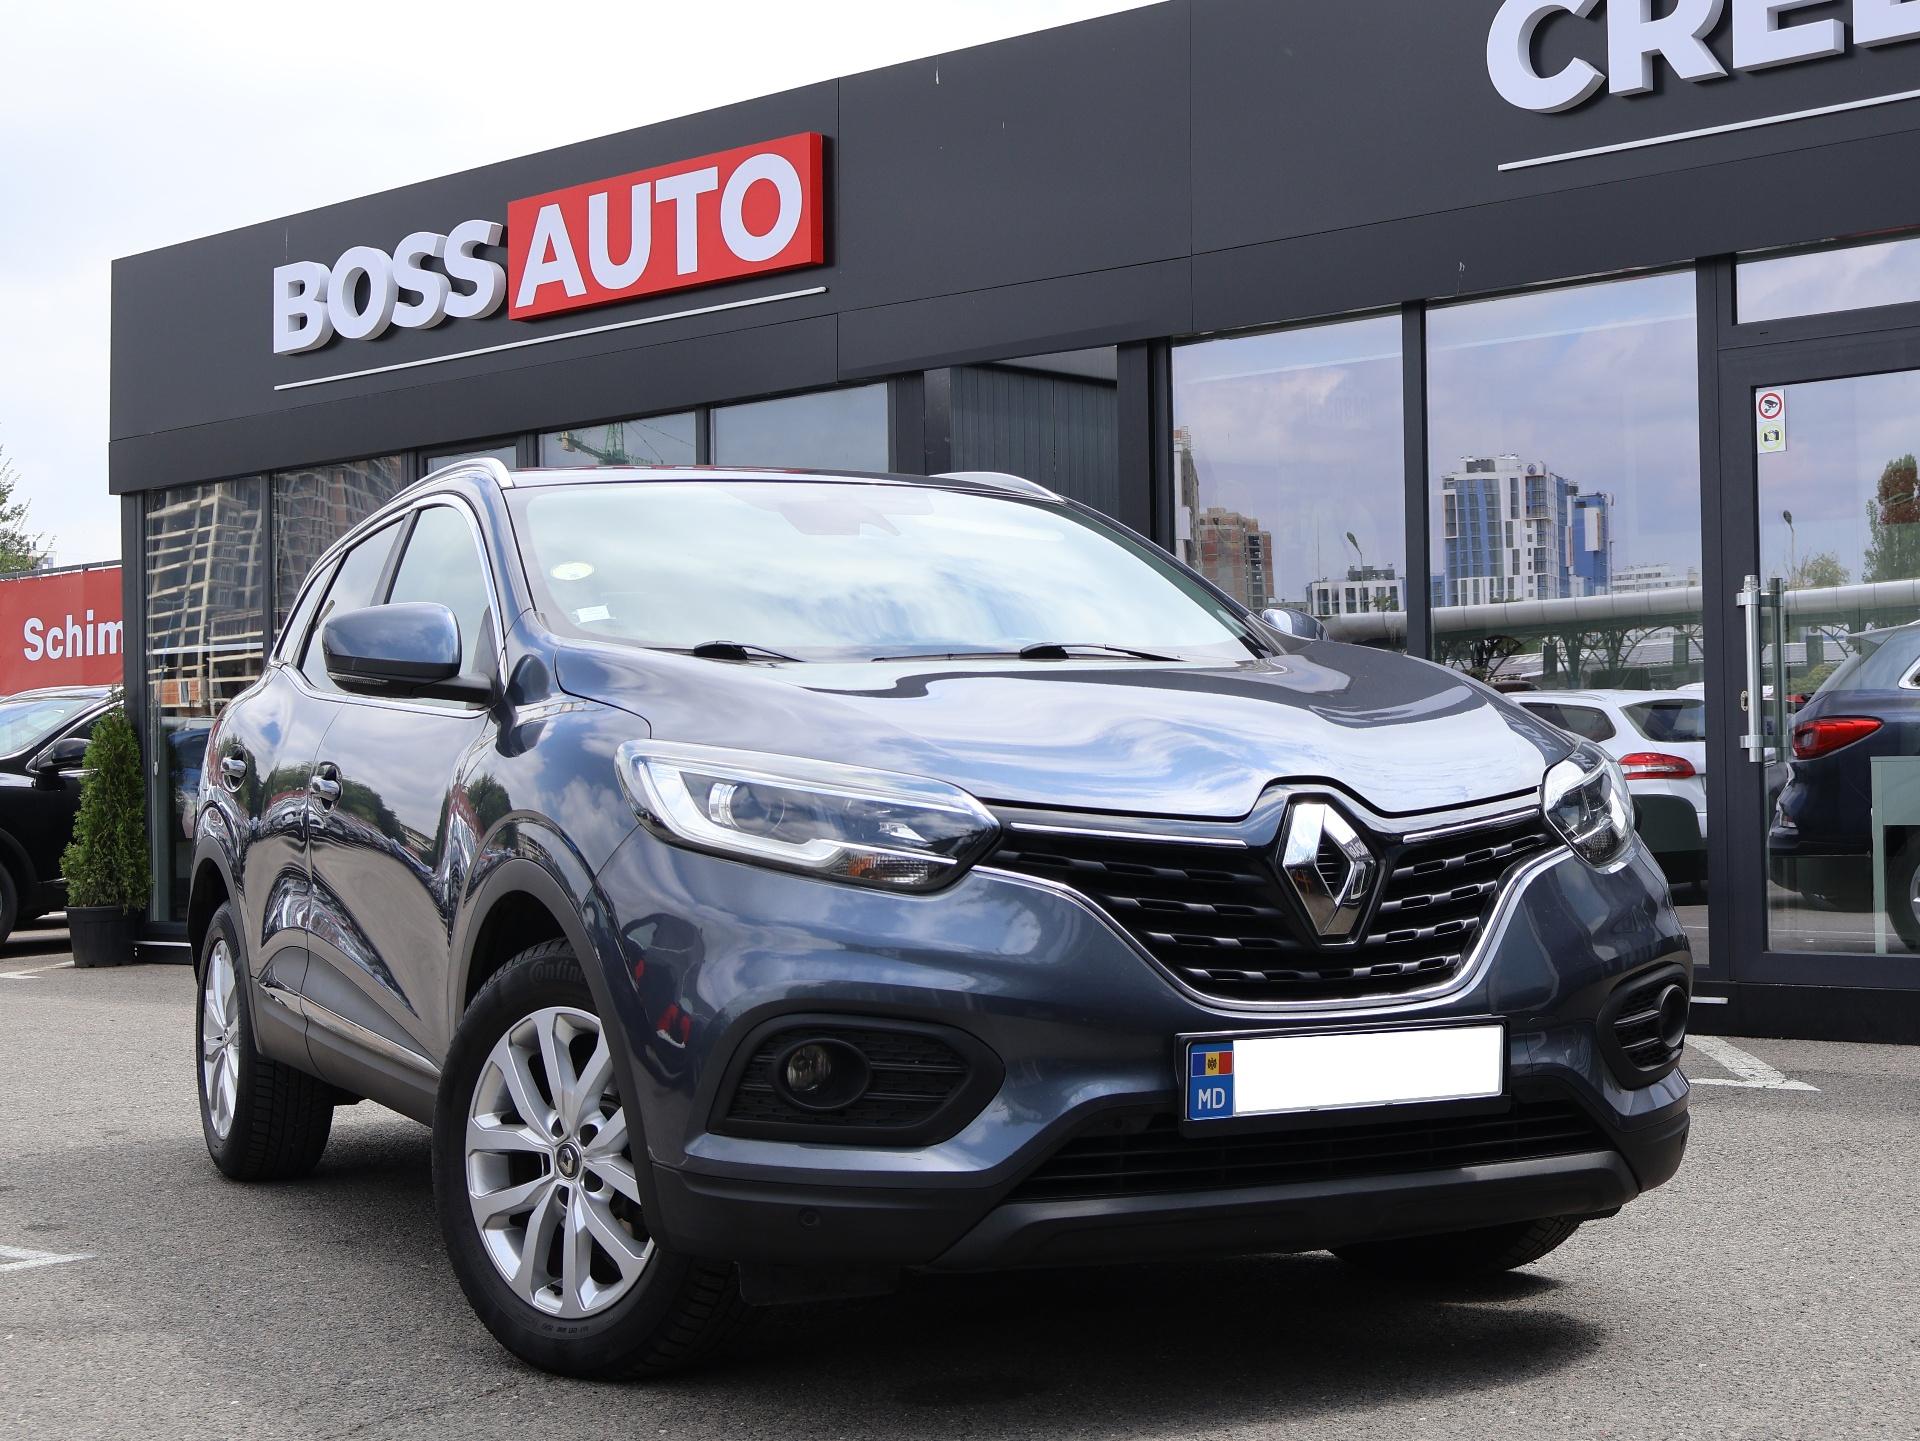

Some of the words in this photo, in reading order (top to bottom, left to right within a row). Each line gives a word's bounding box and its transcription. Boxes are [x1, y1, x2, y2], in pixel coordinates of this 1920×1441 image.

[1487, 0, 1920, 113] CRE
[273, 219, 507, 354] BOSS
[515, 153, 802, 308] AUTO
[1198, 1087, 1226, 1110] MD
